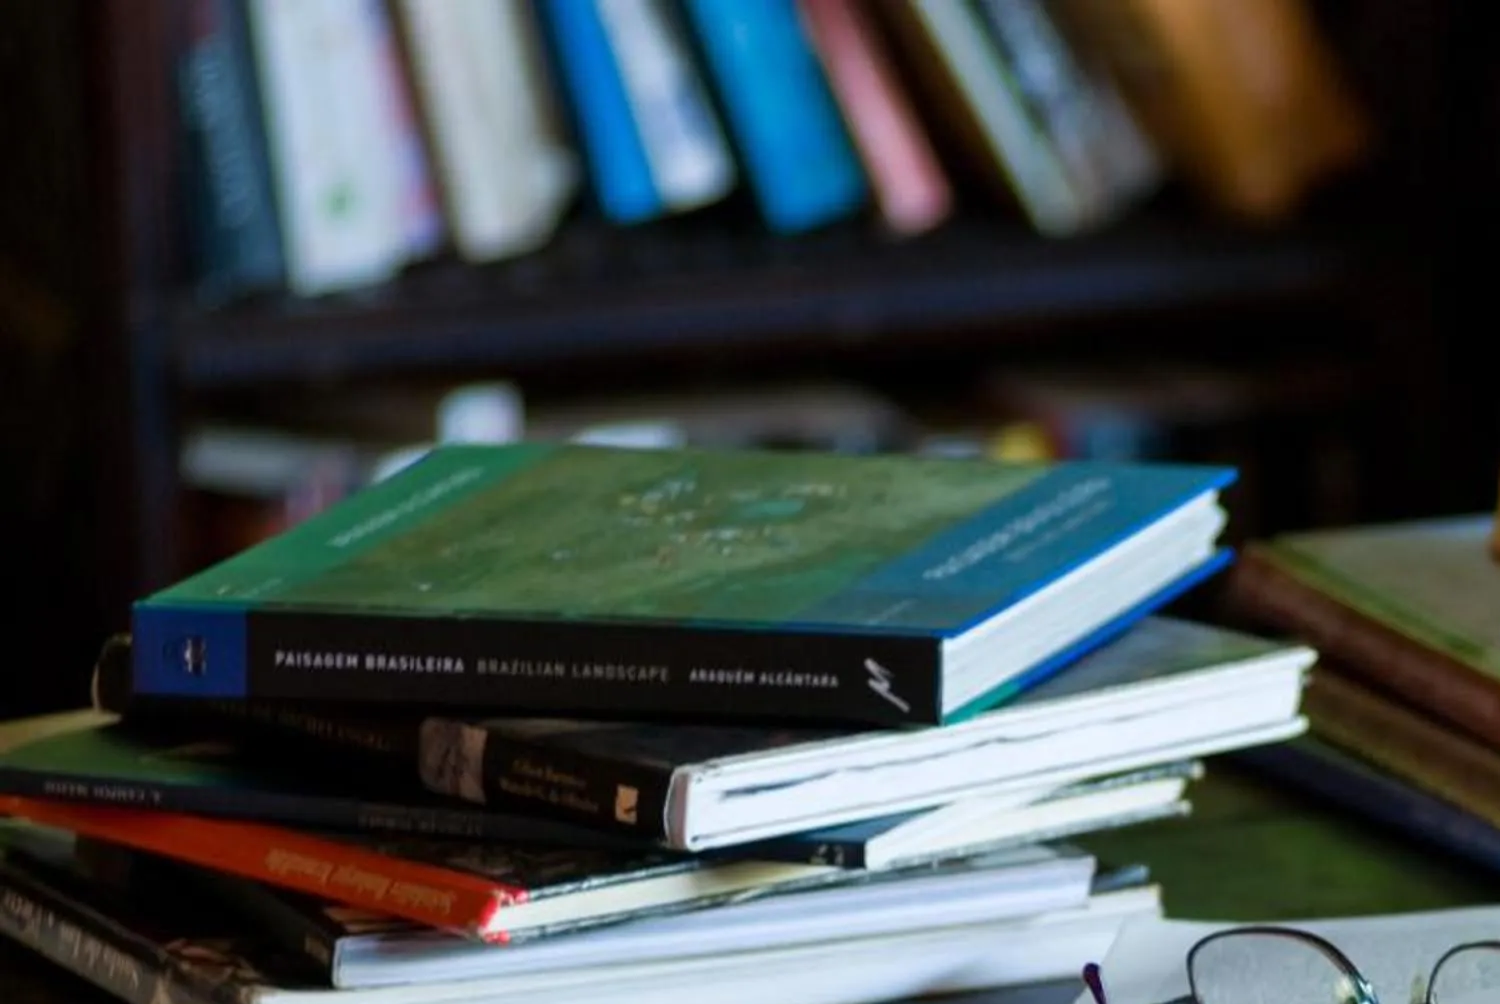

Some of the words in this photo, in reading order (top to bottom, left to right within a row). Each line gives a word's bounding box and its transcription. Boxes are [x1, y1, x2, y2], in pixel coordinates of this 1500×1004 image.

[275, 650, 358, 671] PAISAGEM
[365, 654, 464, 674] BRASILEIRA
[477, 657, 564, 677] BRAZILIAN
[571, 663, 669, 684] LANDSCAPE
